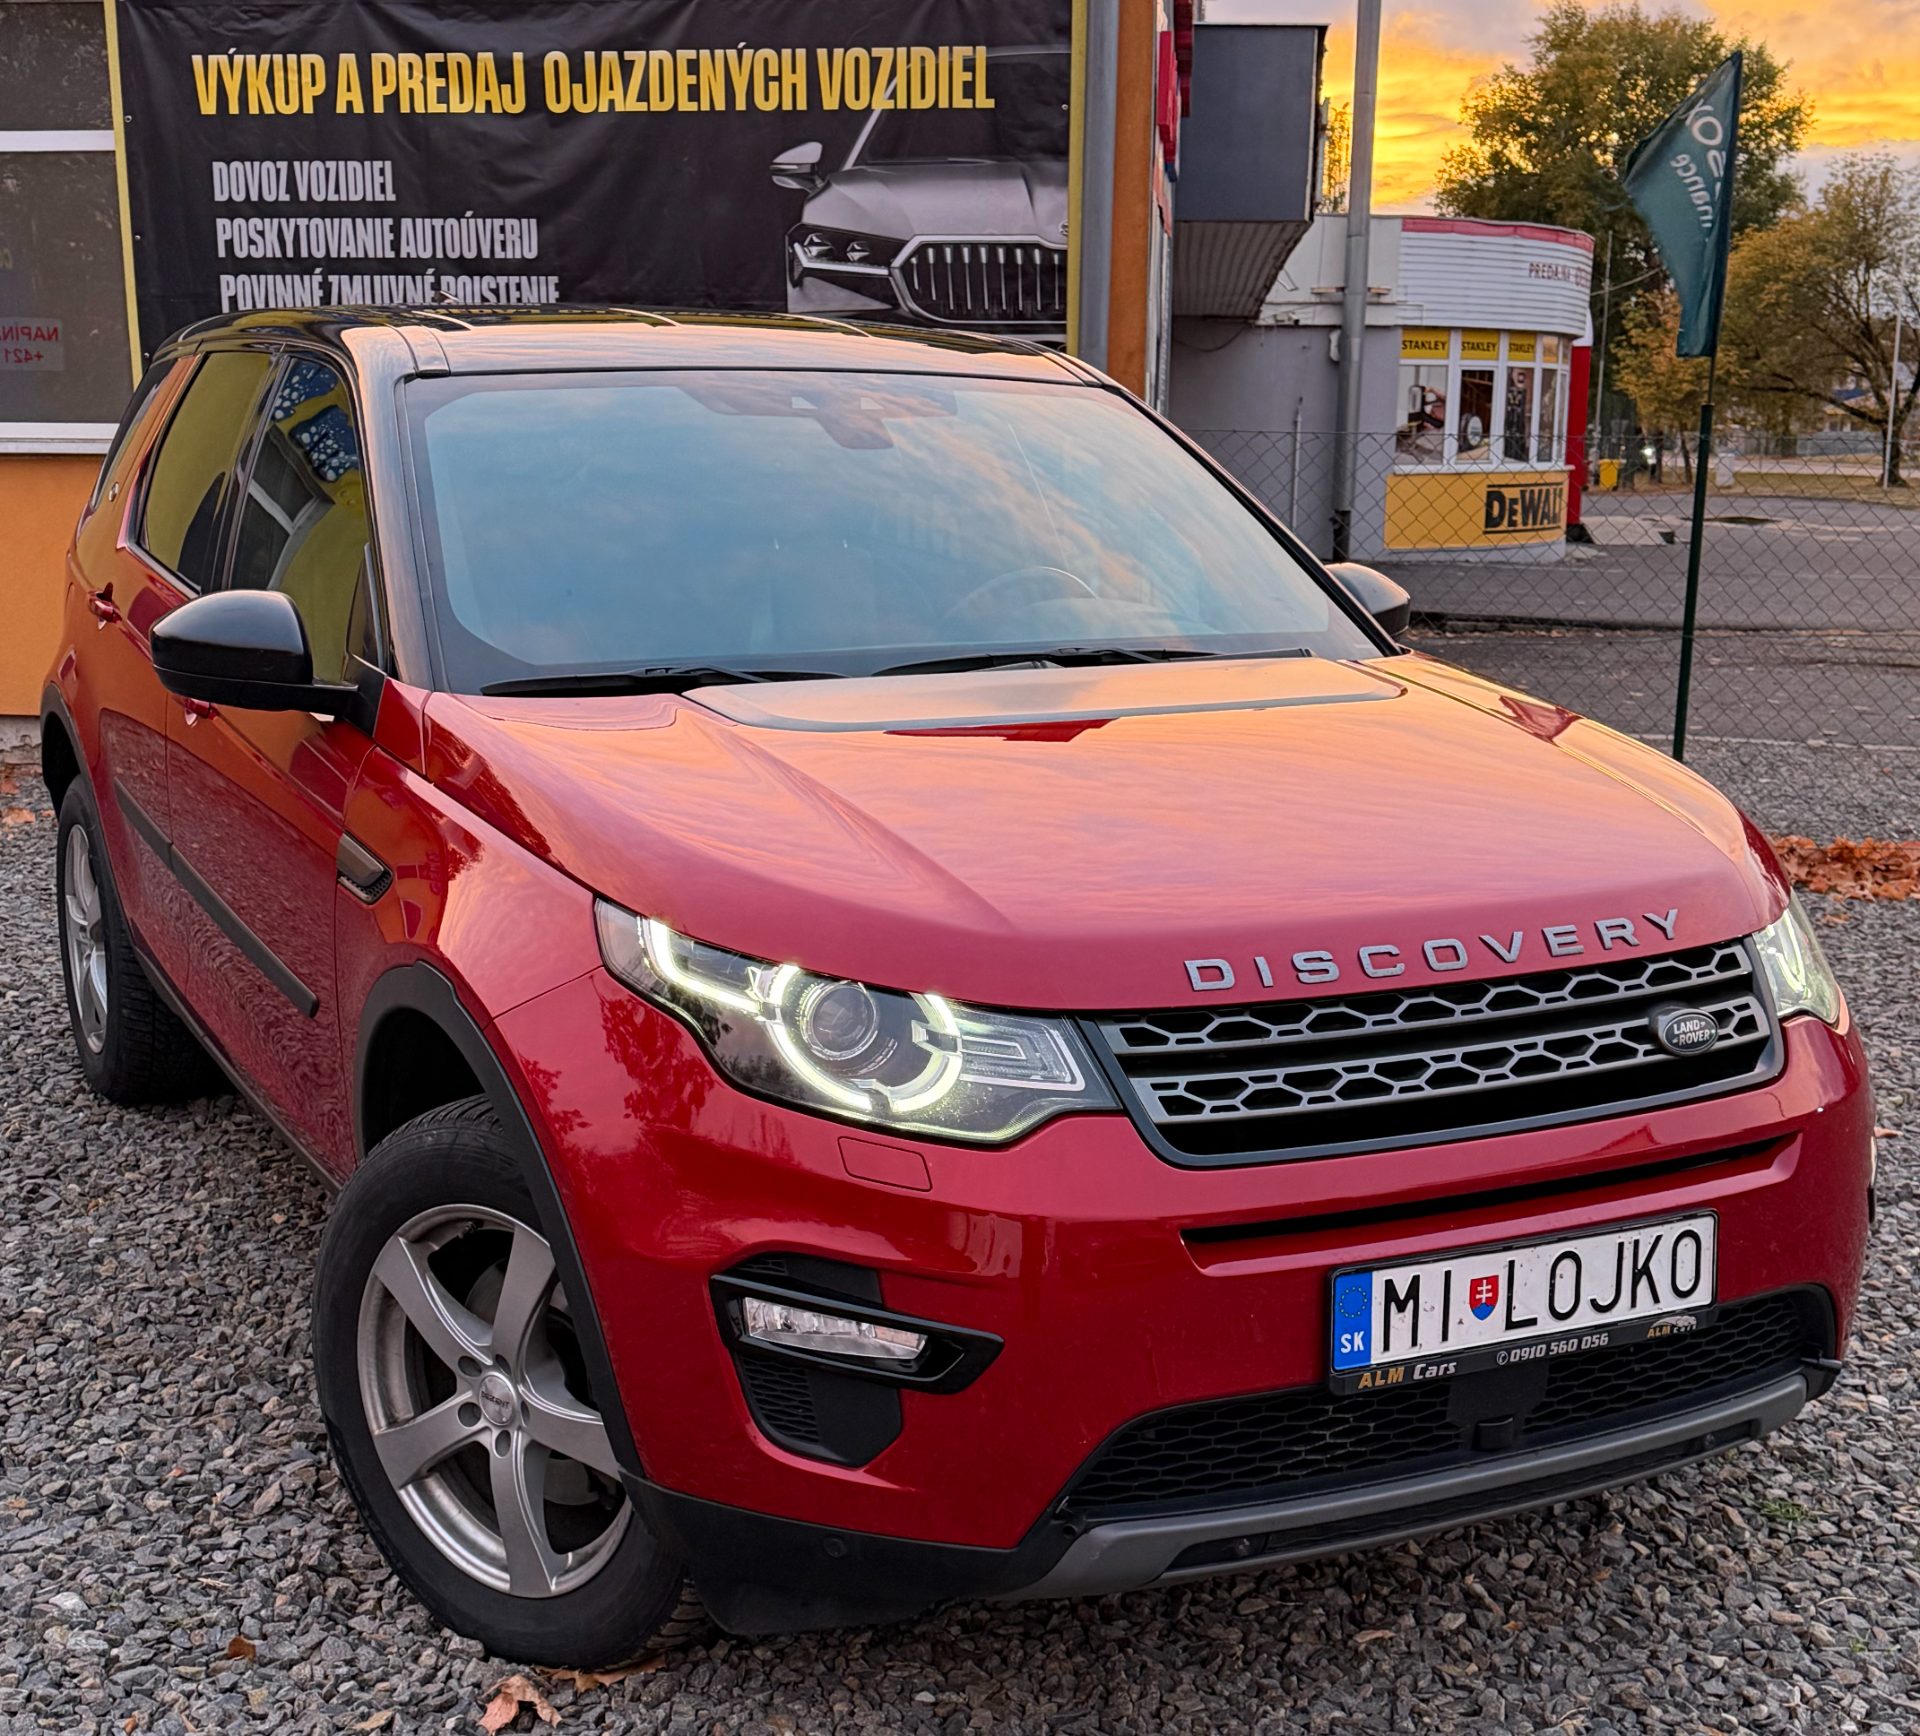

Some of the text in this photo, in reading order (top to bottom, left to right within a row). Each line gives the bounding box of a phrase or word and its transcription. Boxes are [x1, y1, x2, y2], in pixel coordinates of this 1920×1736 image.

[191, 42, 995, 115] VÝKUP A PREDAJ OJAZDENÝCH VOZIDIEL
[212, 160, 396, 202] DOVOZ VOZIDIEL
[216, 211, 538, 259] POSKYTOVANIE AUTOÚVERU
[220, 267, 324, 314] POVINNÉ
[1402, 340, 1448, 351] STANLEY
[1461, 341, 1498, 352] STANLEY
[1184, 908, 1680, 991] DISCOVERY
[1673, 1019, 1700, 1035] LAND
[1678, 1029, 1710, 1046] ROVER
[1382, 1228, 1702, 1353] MI LOJKO
[1340, 1330, 1365, 1354] SK
[1358, 1366, 1405, 1389] ALM
[1412, 1362, 1457, 1380] Cars
[1549, 1338, 1579, 1356] 560
[1581, 1333, 1609, 1350] 056
